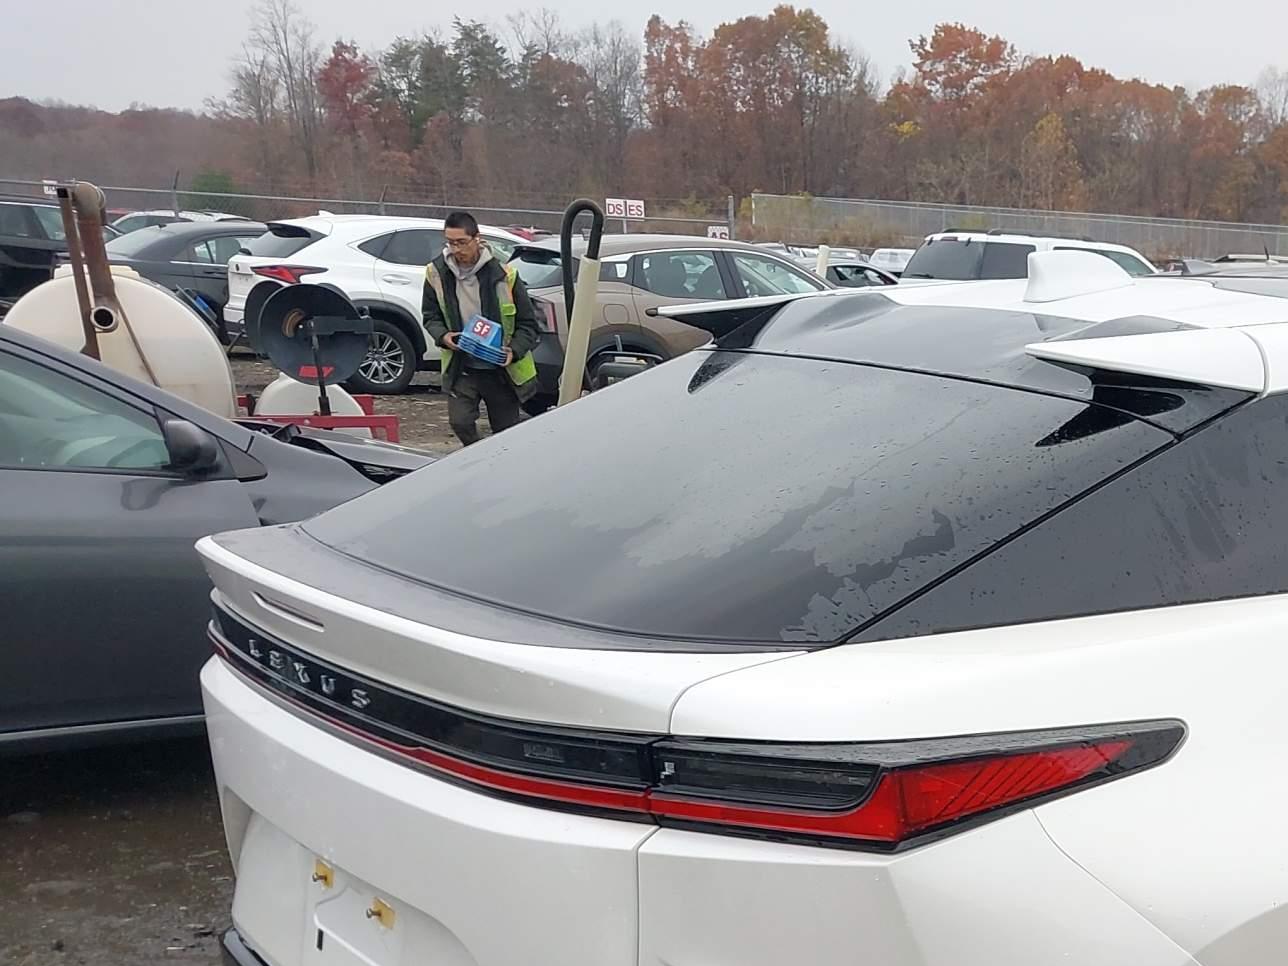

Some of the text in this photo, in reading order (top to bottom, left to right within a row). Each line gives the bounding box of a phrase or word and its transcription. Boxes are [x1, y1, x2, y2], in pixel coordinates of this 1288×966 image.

[608, 203, 623, 215] DS
[628, 204, 643, 217] ES
[474, 321, 490, 335] SF
[248, 639, 371, 709] LEXUS
